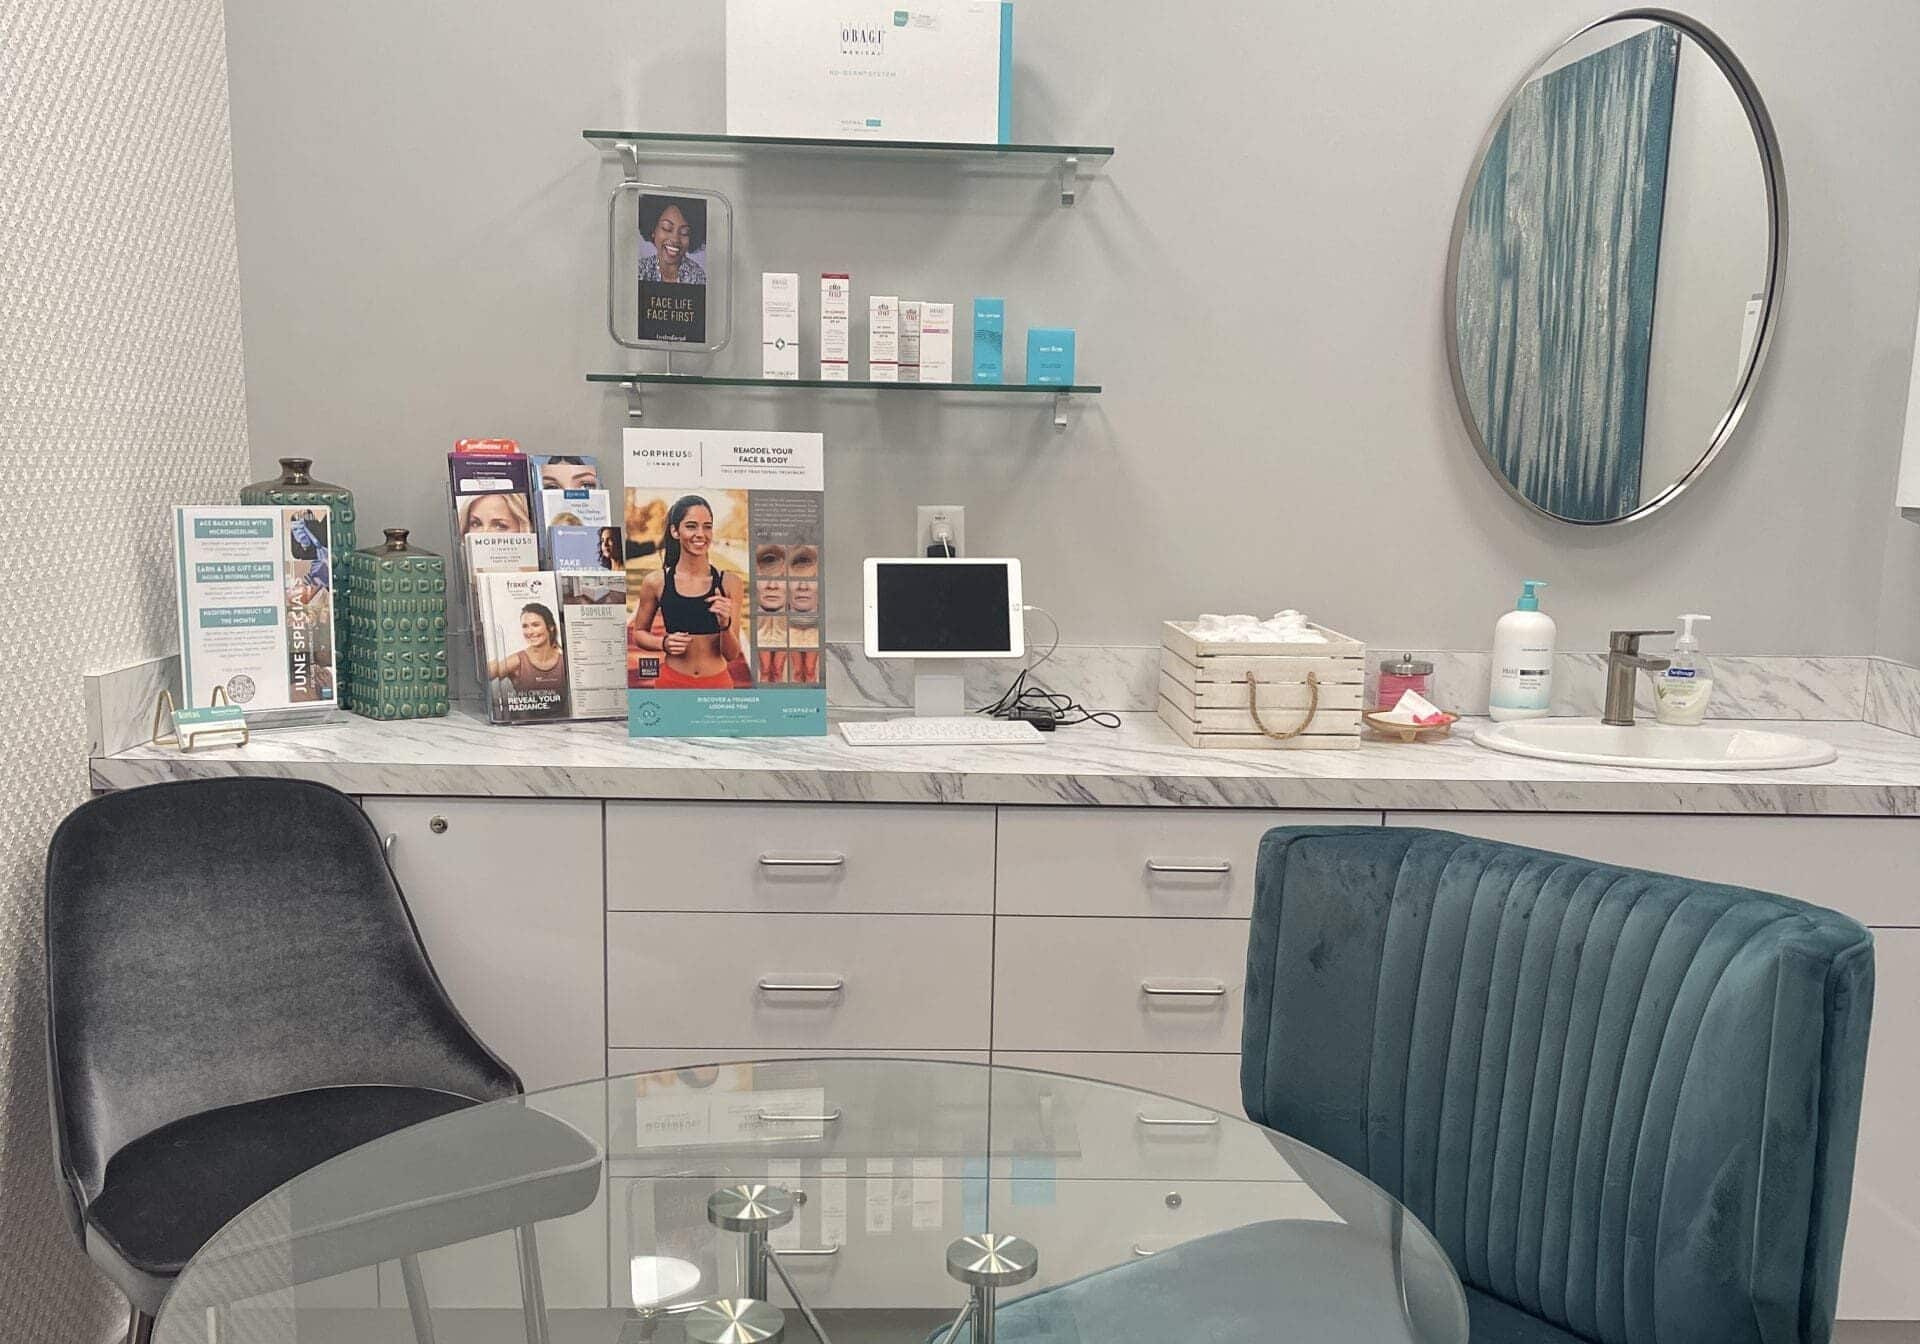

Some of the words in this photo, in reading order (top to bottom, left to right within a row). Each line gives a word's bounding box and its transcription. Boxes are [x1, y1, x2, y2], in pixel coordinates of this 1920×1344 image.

[842, 28, 882, 44] OBAGI
[651, 296, 672, 309] FACE
[675, 299, 693, 310] LIFE
[647, 309, 668, 321] FACE
[671, 311, 695, 322] FIRST
[733, 447, 771, 455] REMODEL
[559, 558, 580, 566] TAKE
[233, 607, 261, 616] PRODUCT
[233, 617, 256, 625] MONTH
[294, 652, 307, 694] JUNE
[508, 697, 537, 705] REVEAL
